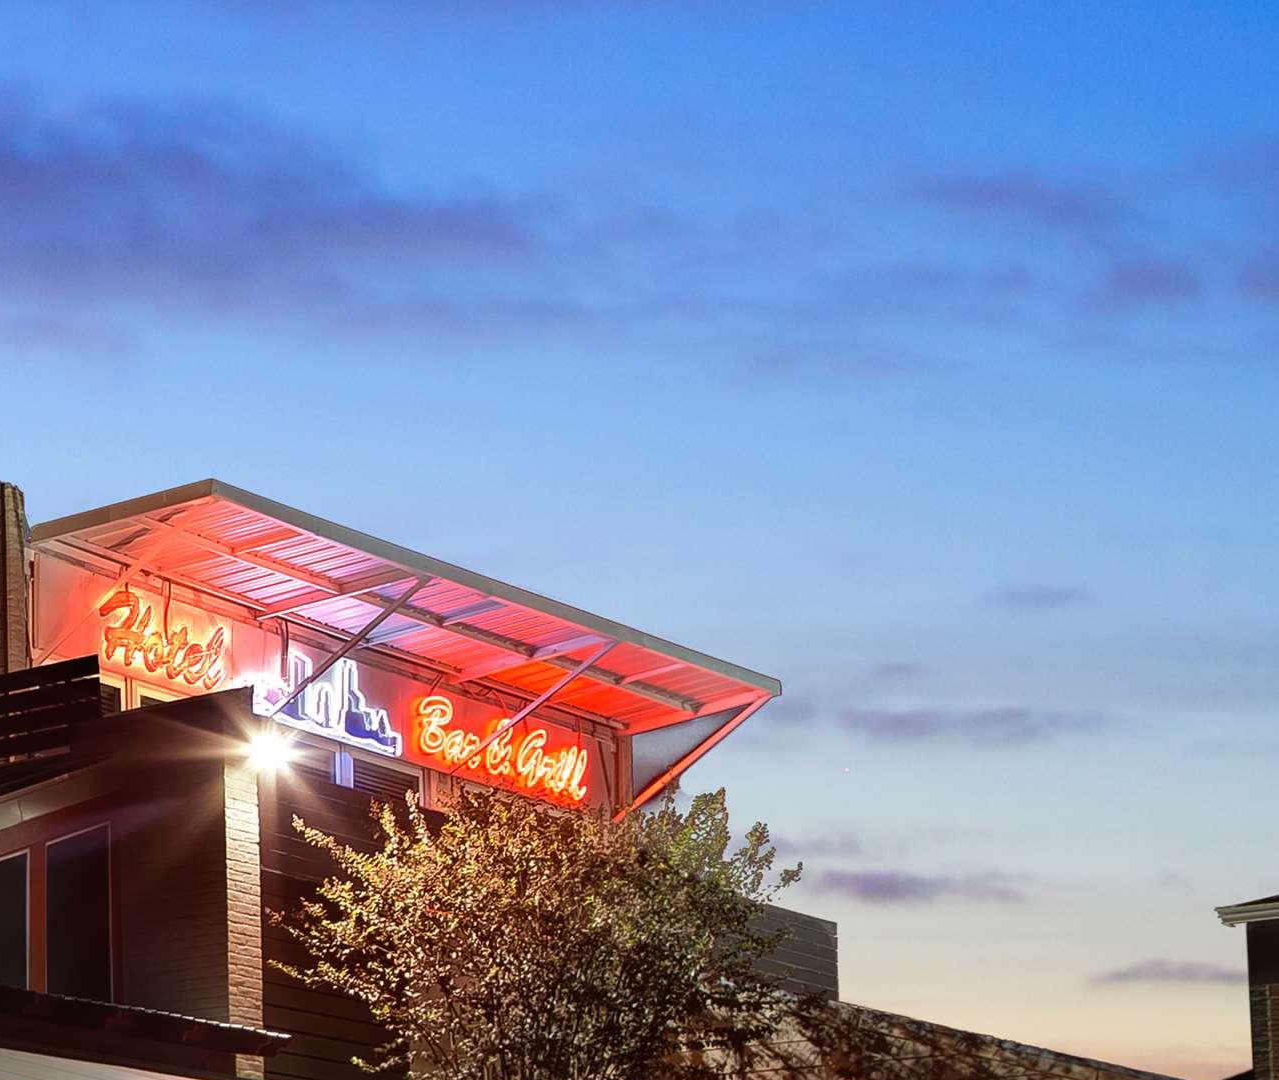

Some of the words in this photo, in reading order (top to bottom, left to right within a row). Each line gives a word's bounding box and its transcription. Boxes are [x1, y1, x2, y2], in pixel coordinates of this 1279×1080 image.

[99, 591, 225, 690] Hotel
[419, 695, 480, 769] Bar
[486, 718, 514, 775] &
[517, 729, 588, 801] Grill
